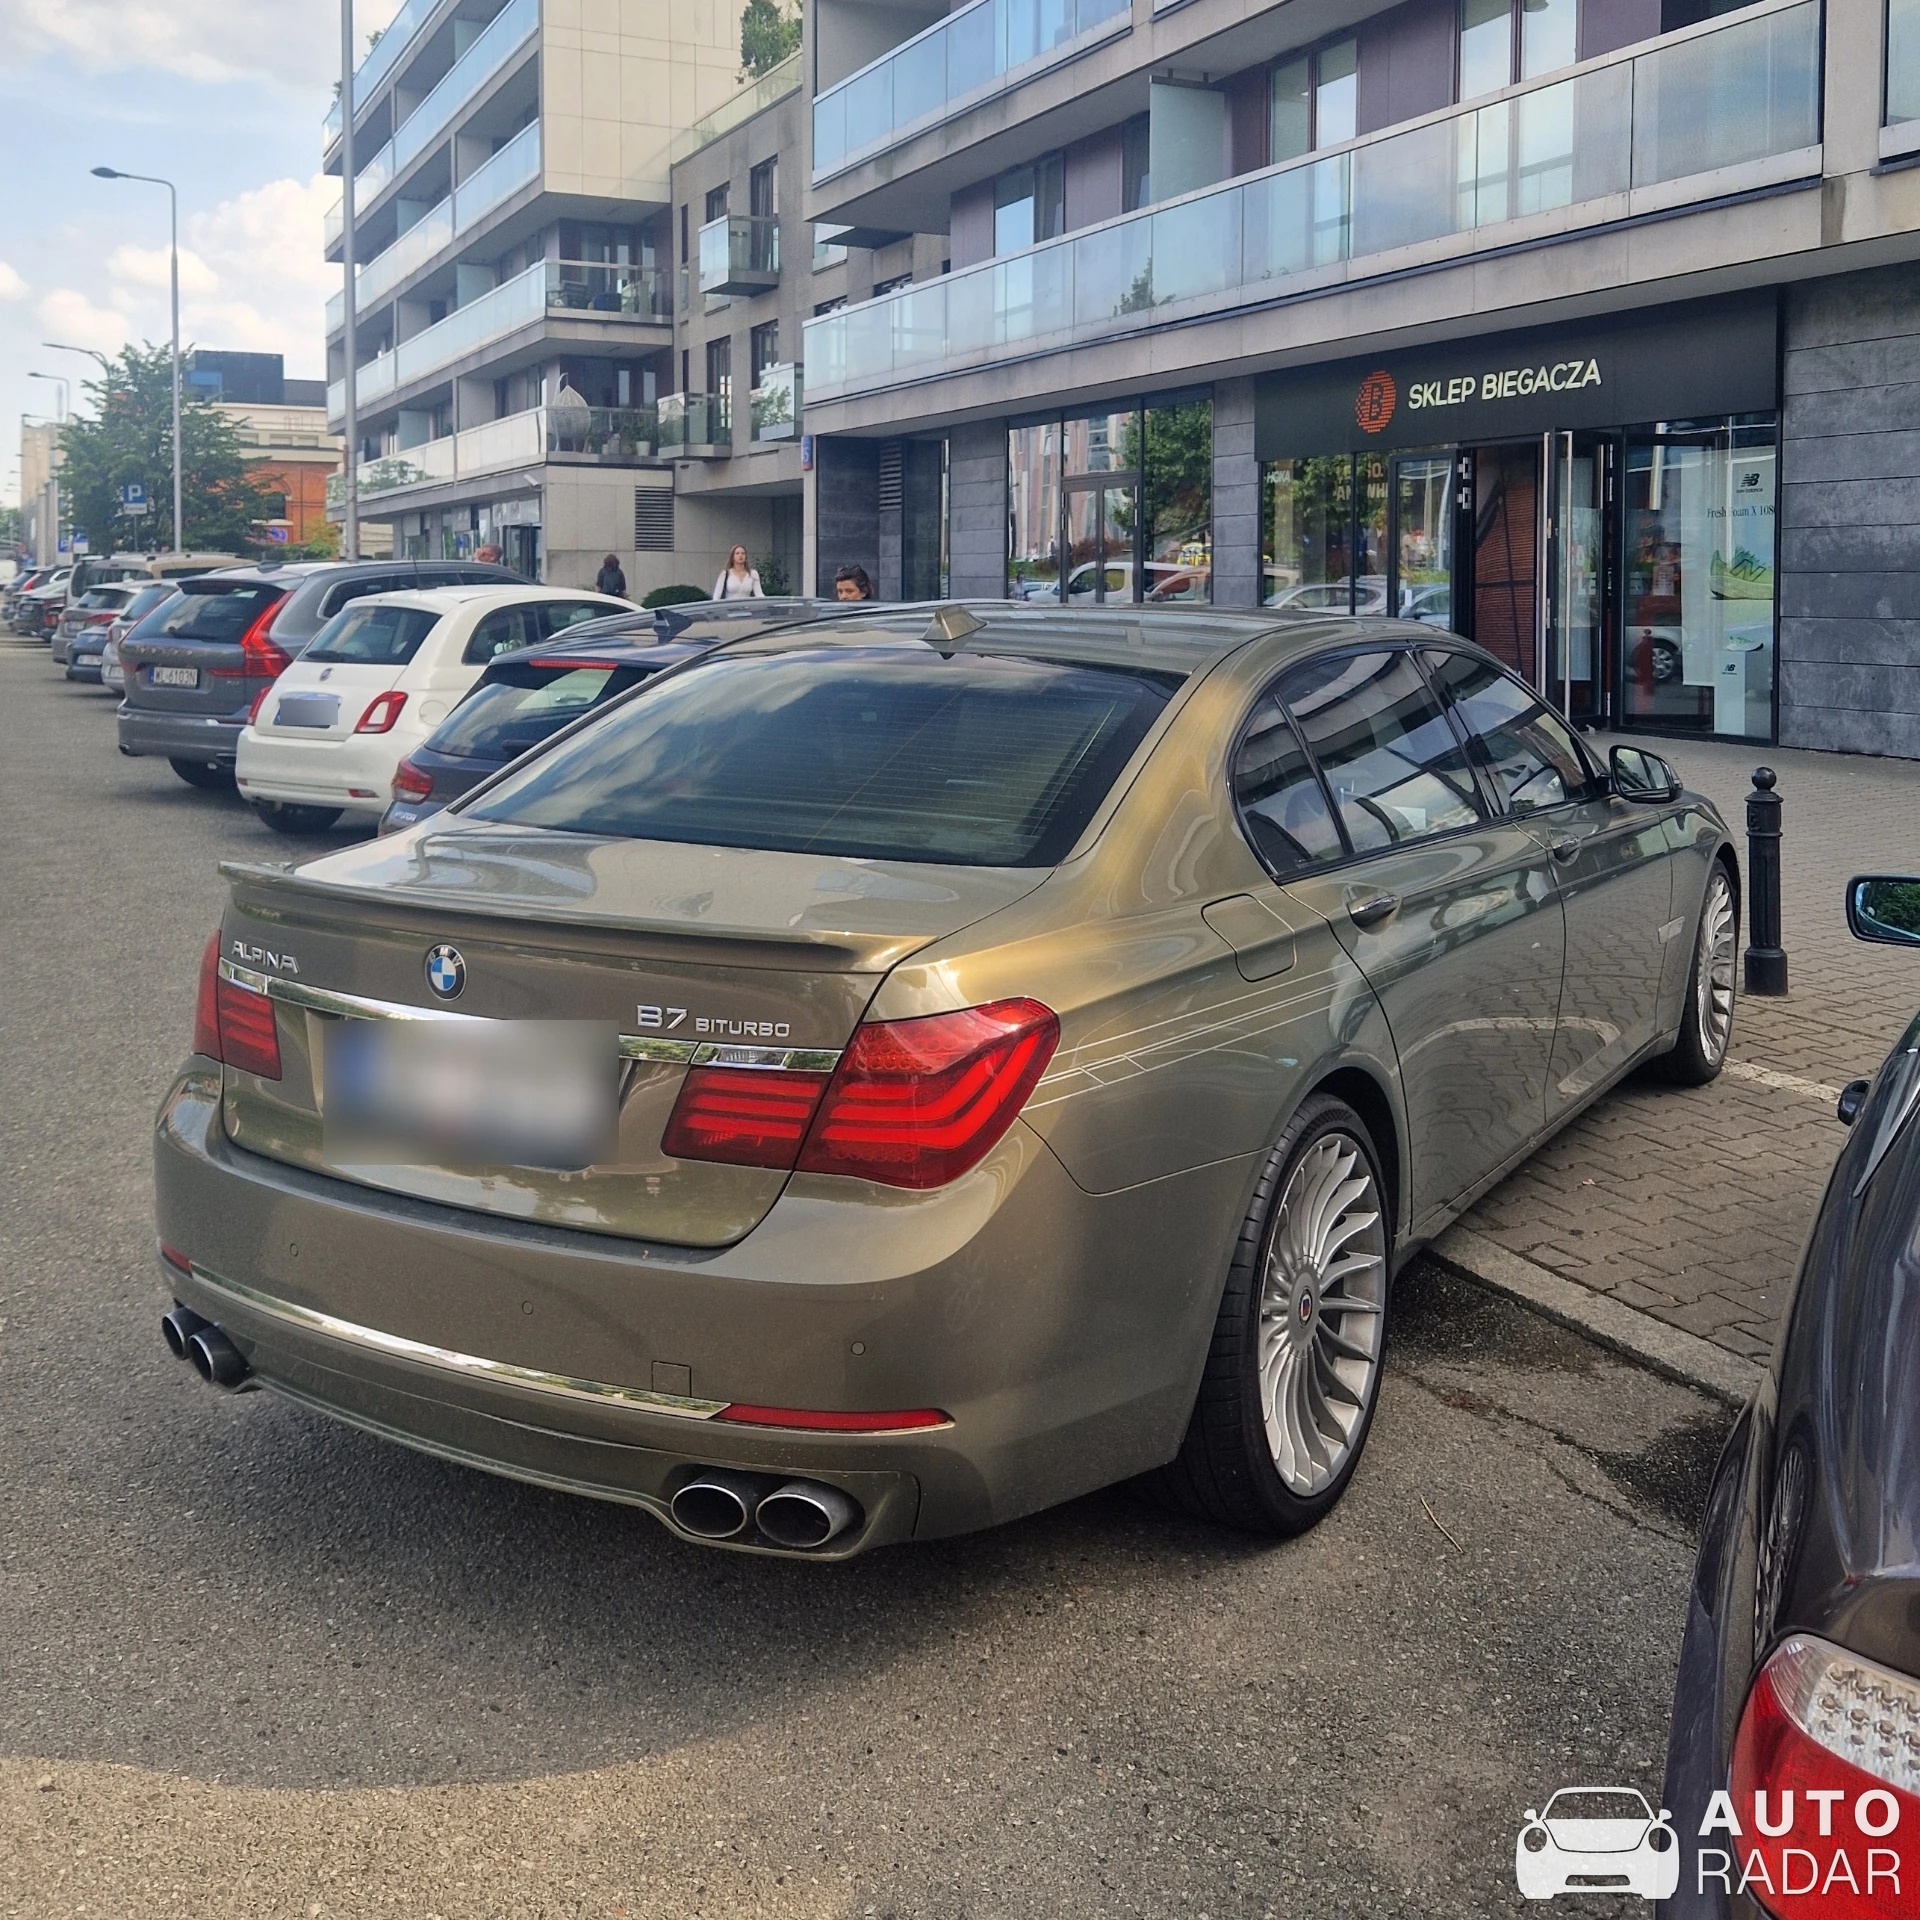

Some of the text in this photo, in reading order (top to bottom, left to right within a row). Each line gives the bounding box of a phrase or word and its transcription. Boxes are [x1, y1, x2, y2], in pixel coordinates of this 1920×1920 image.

[1408, 358, 1602, 410] SKLEP BIEGACZA
[1266, 470, 1291, 484] HOKA
[128, 485, 142, 501] P
[1707, 506, 1727, 518] Fresh
[1729, 508, 1749, 517] oam
[1751, 505, 1759, 516] X
[231, 940, 299, 974] ALPINA
[427, 946, 462, 967] BMW
[637, 1004, 790, 1038] B7 BITURBO
